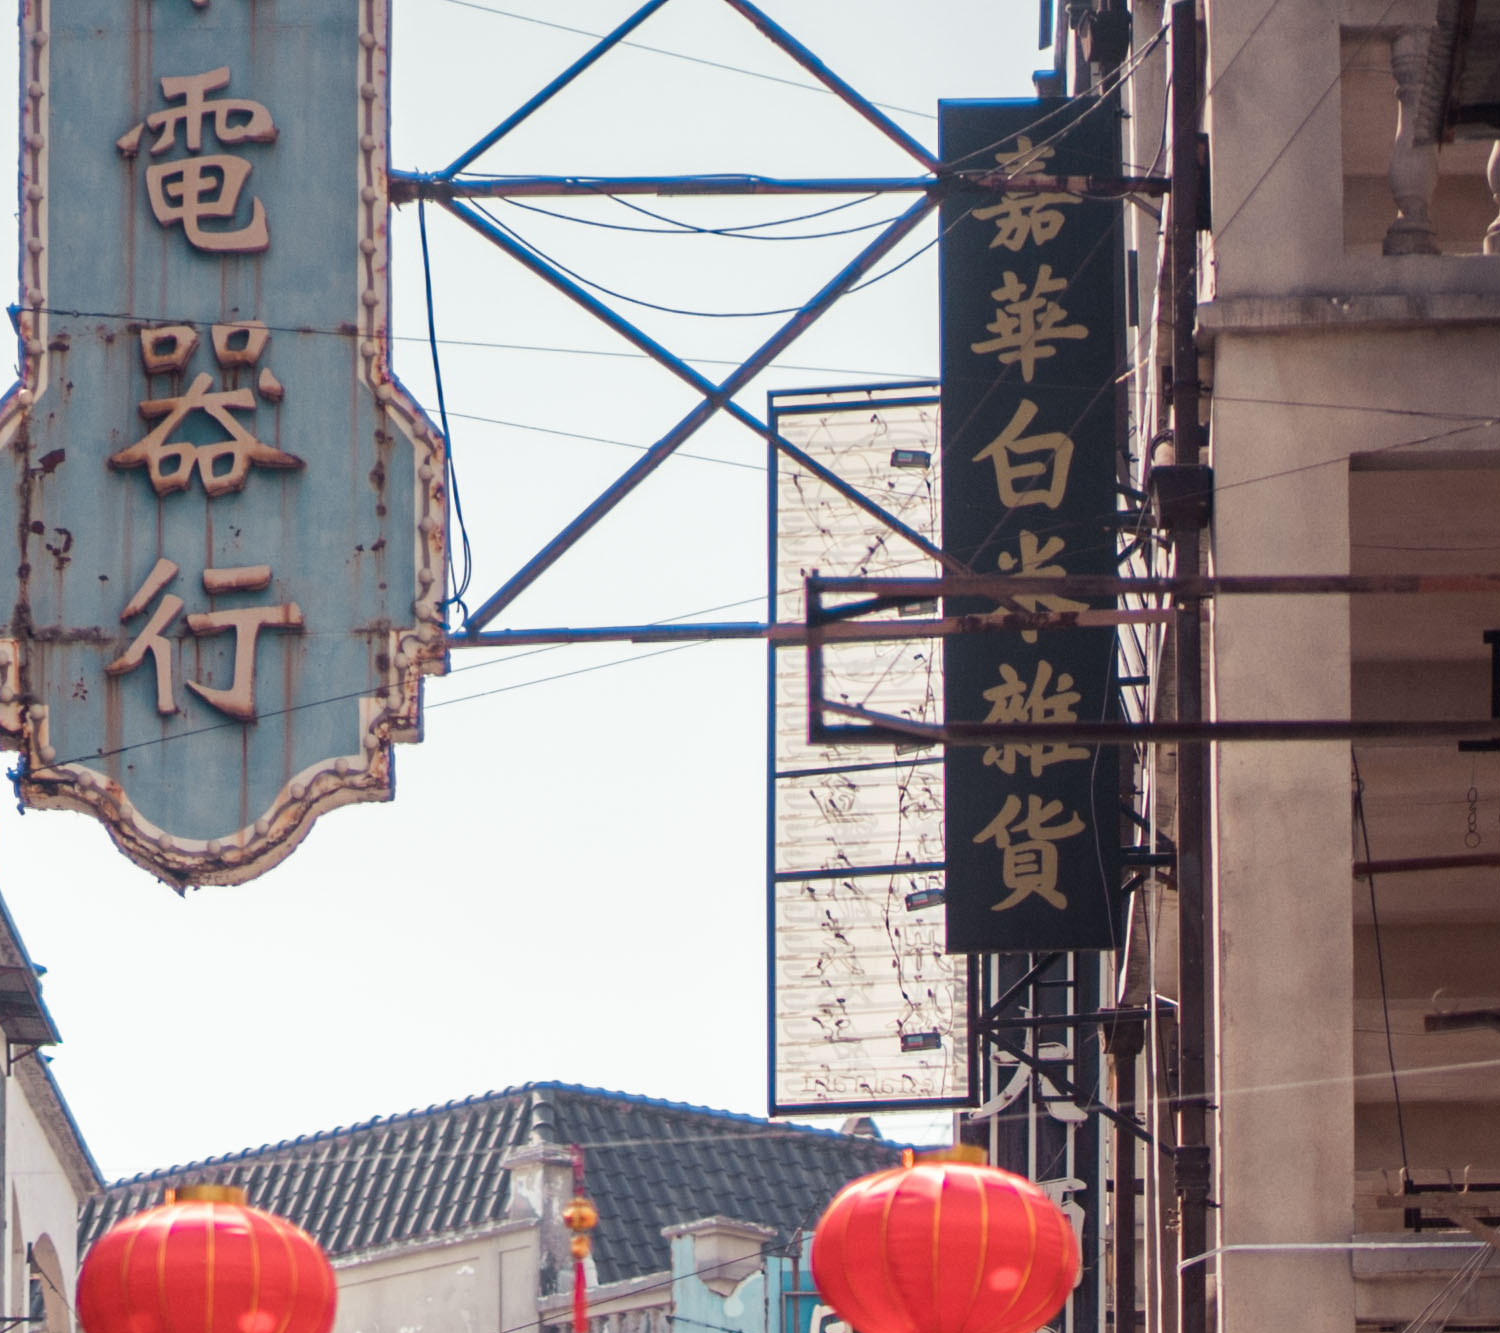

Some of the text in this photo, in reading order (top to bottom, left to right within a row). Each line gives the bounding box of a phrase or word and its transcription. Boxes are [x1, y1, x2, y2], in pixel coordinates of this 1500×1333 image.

[105, 64, 305, 725] 電器行
[971, 134, 1088, 911] 嘉華白米雜貨
